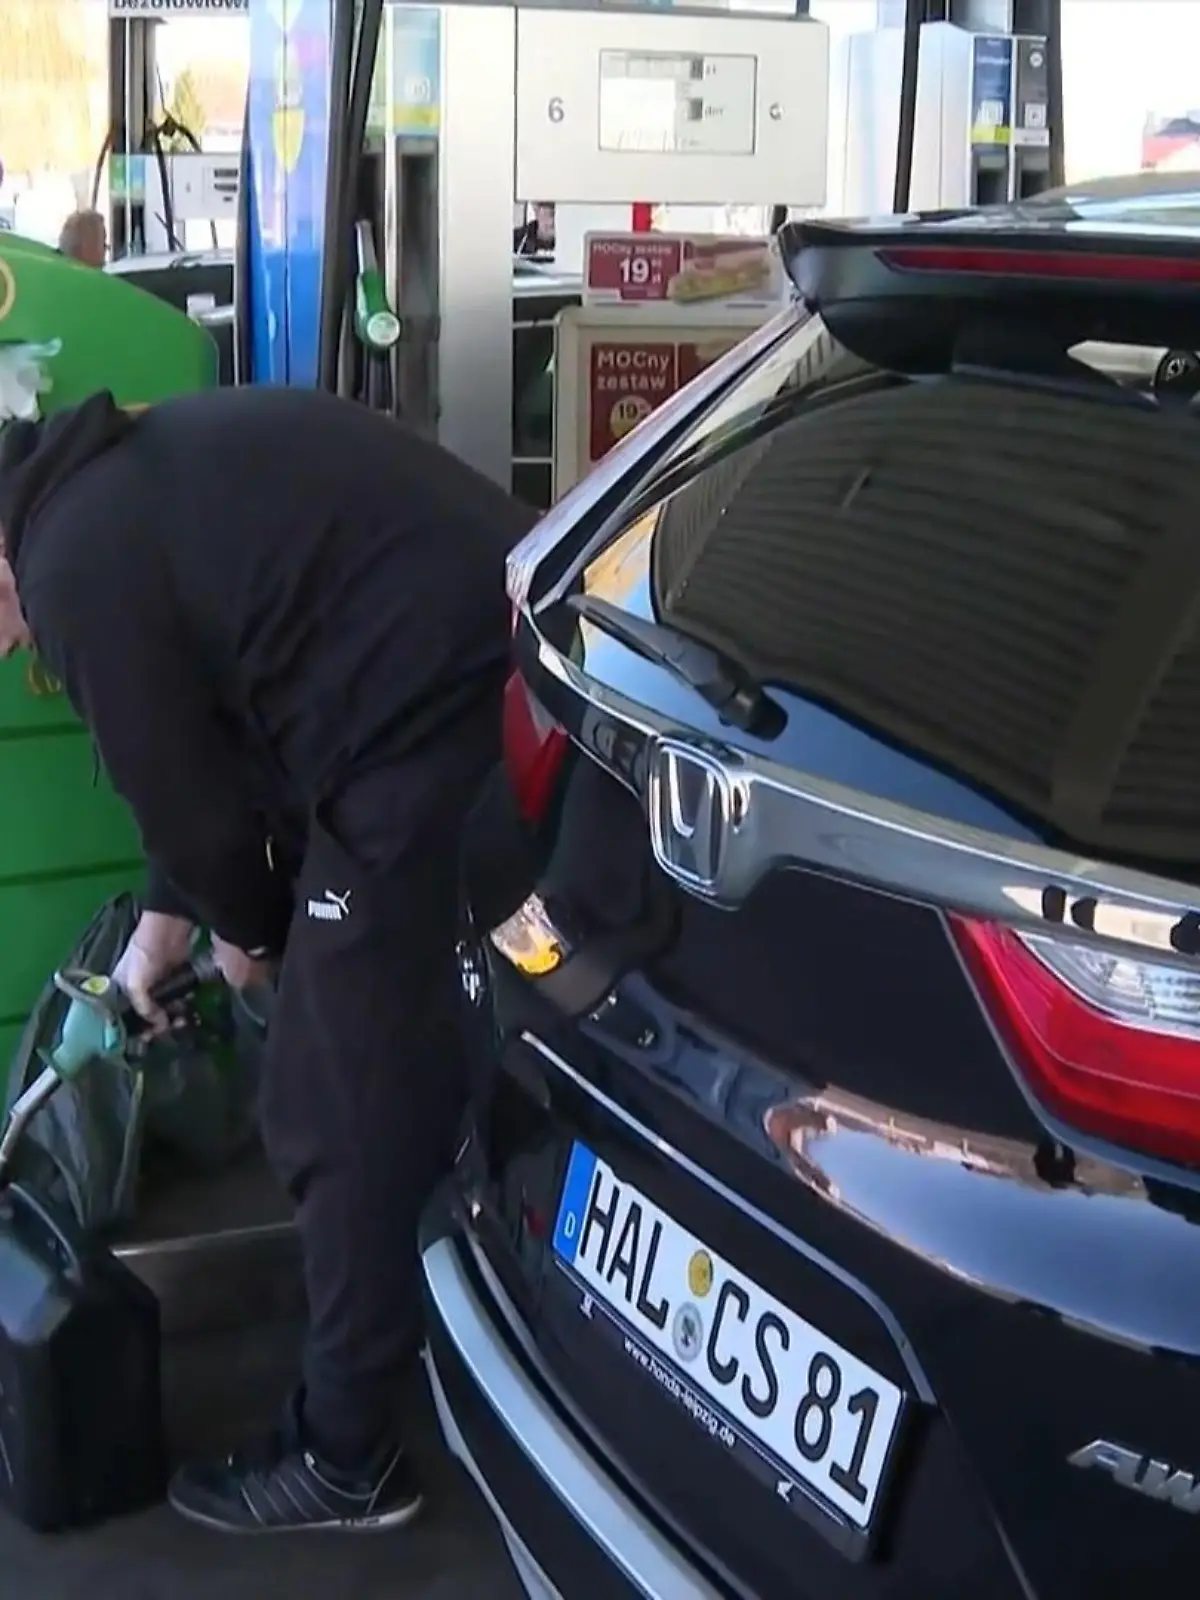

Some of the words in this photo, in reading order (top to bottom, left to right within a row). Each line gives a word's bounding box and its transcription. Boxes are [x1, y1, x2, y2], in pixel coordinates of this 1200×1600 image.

[548, 96, 564, 123] 6
[620, 257, 650, 284] 19
[597, 350, 669, 372] MOCny
[597, 373, 668, 390] zestaw
[564, 1210, 577, 1240] D
[579, 1169, 670, 1331] HAL
[706, 1279, 790, 1419] CS
[794, 1350, 880, 1506] 81
